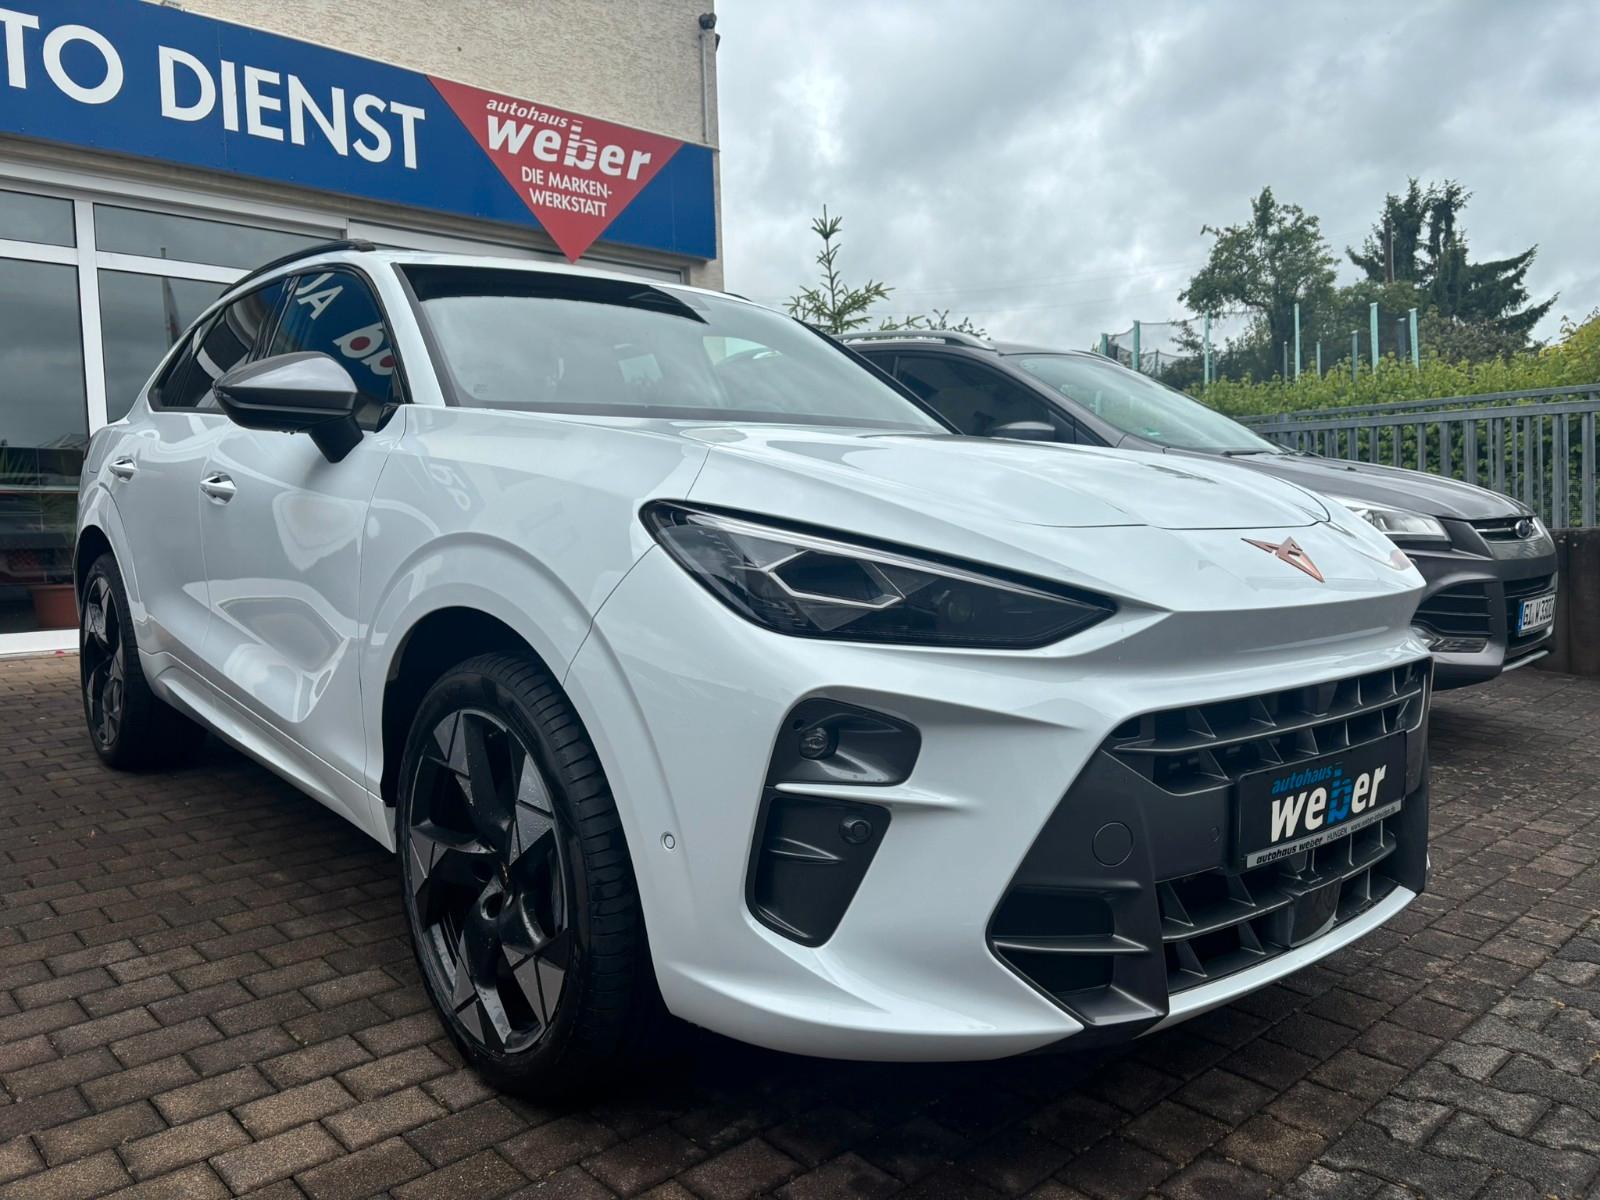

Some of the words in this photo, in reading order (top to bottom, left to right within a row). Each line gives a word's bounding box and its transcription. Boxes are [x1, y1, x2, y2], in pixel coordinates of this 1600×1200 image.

[0, 9, 124, 104] TO
[158, 45, 426, 170] DIENST
[486, 99, 569, 129] autohaus
[487, 119, 652, 181] weber
[521, 166, 544, 186] DIE
[548, 171, 613, 198] MARKEN-
[529, 188, 608, 218] WERKSTATT
[1271, 765, 1333, 795] autohaus
[1271, 761, 1387, 843] weber
[1256, 844, 1298, 865] autohaus
[1299, 836, 1324, 852] weber
